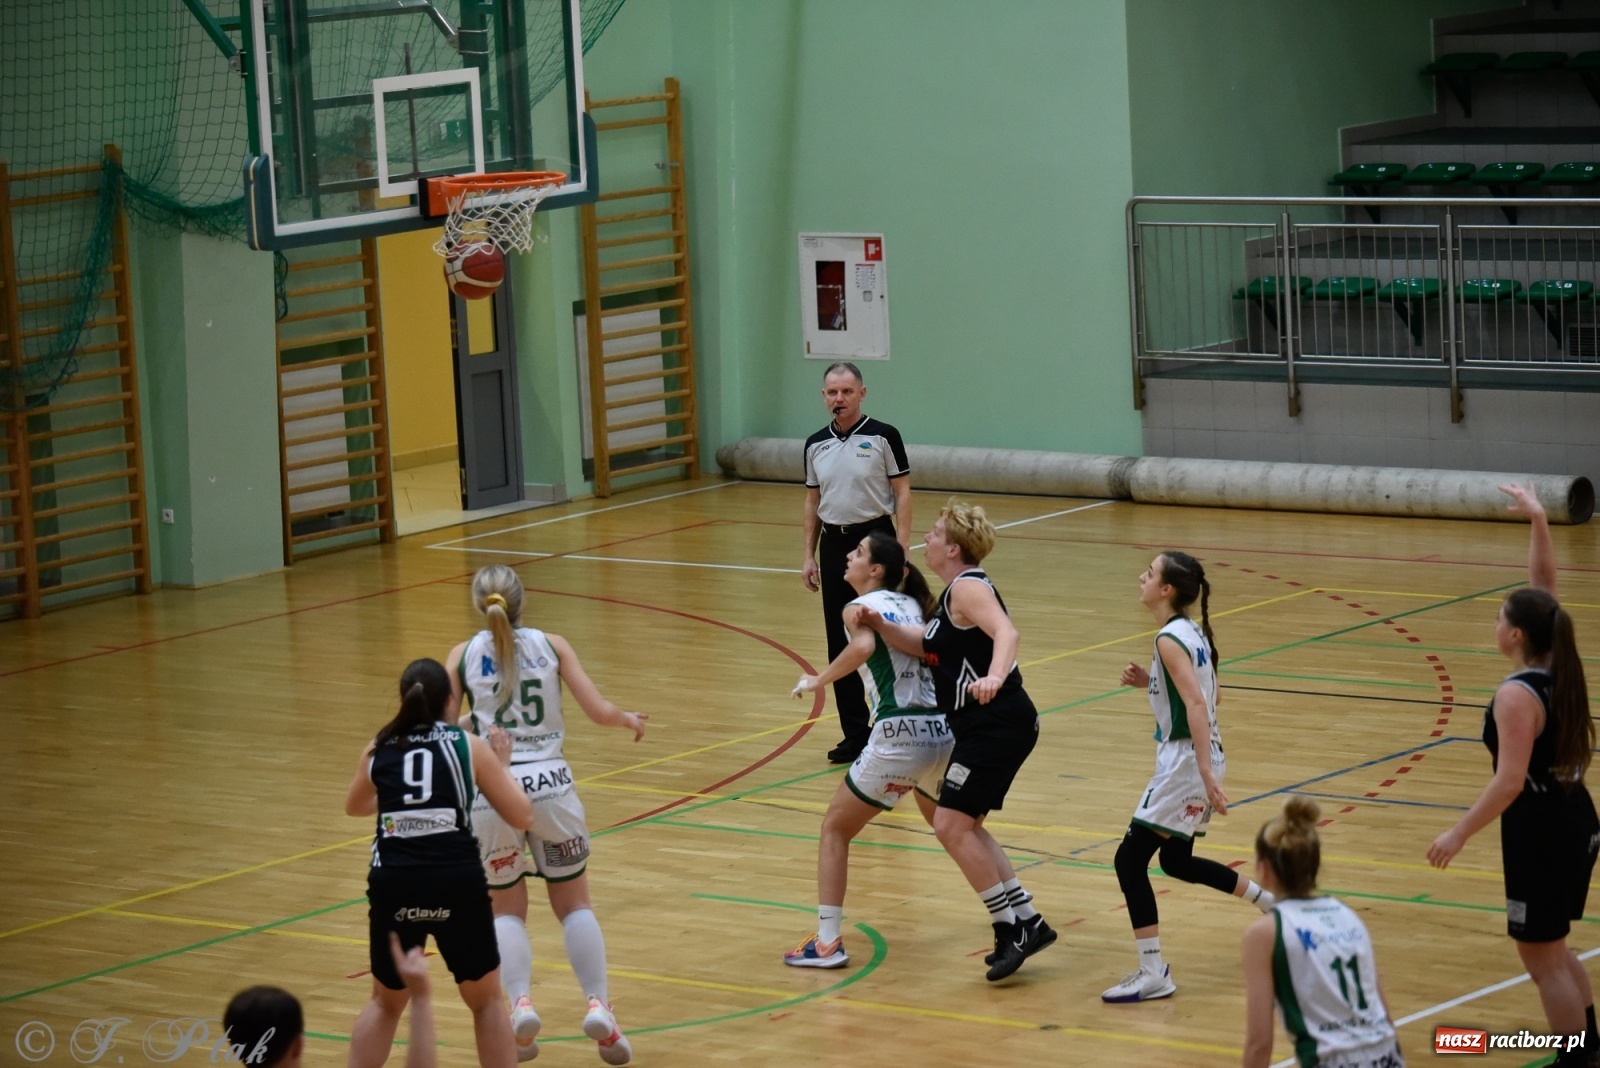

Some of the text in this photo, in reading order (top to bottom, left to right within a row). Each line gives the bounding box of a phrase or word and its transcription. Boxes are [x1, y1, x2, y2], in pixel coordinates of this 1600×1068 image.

[403, 748, 433, 805] 9
[407, 906, 451, 920] Clavis
[1330, 954, 1369, 1010] 11
